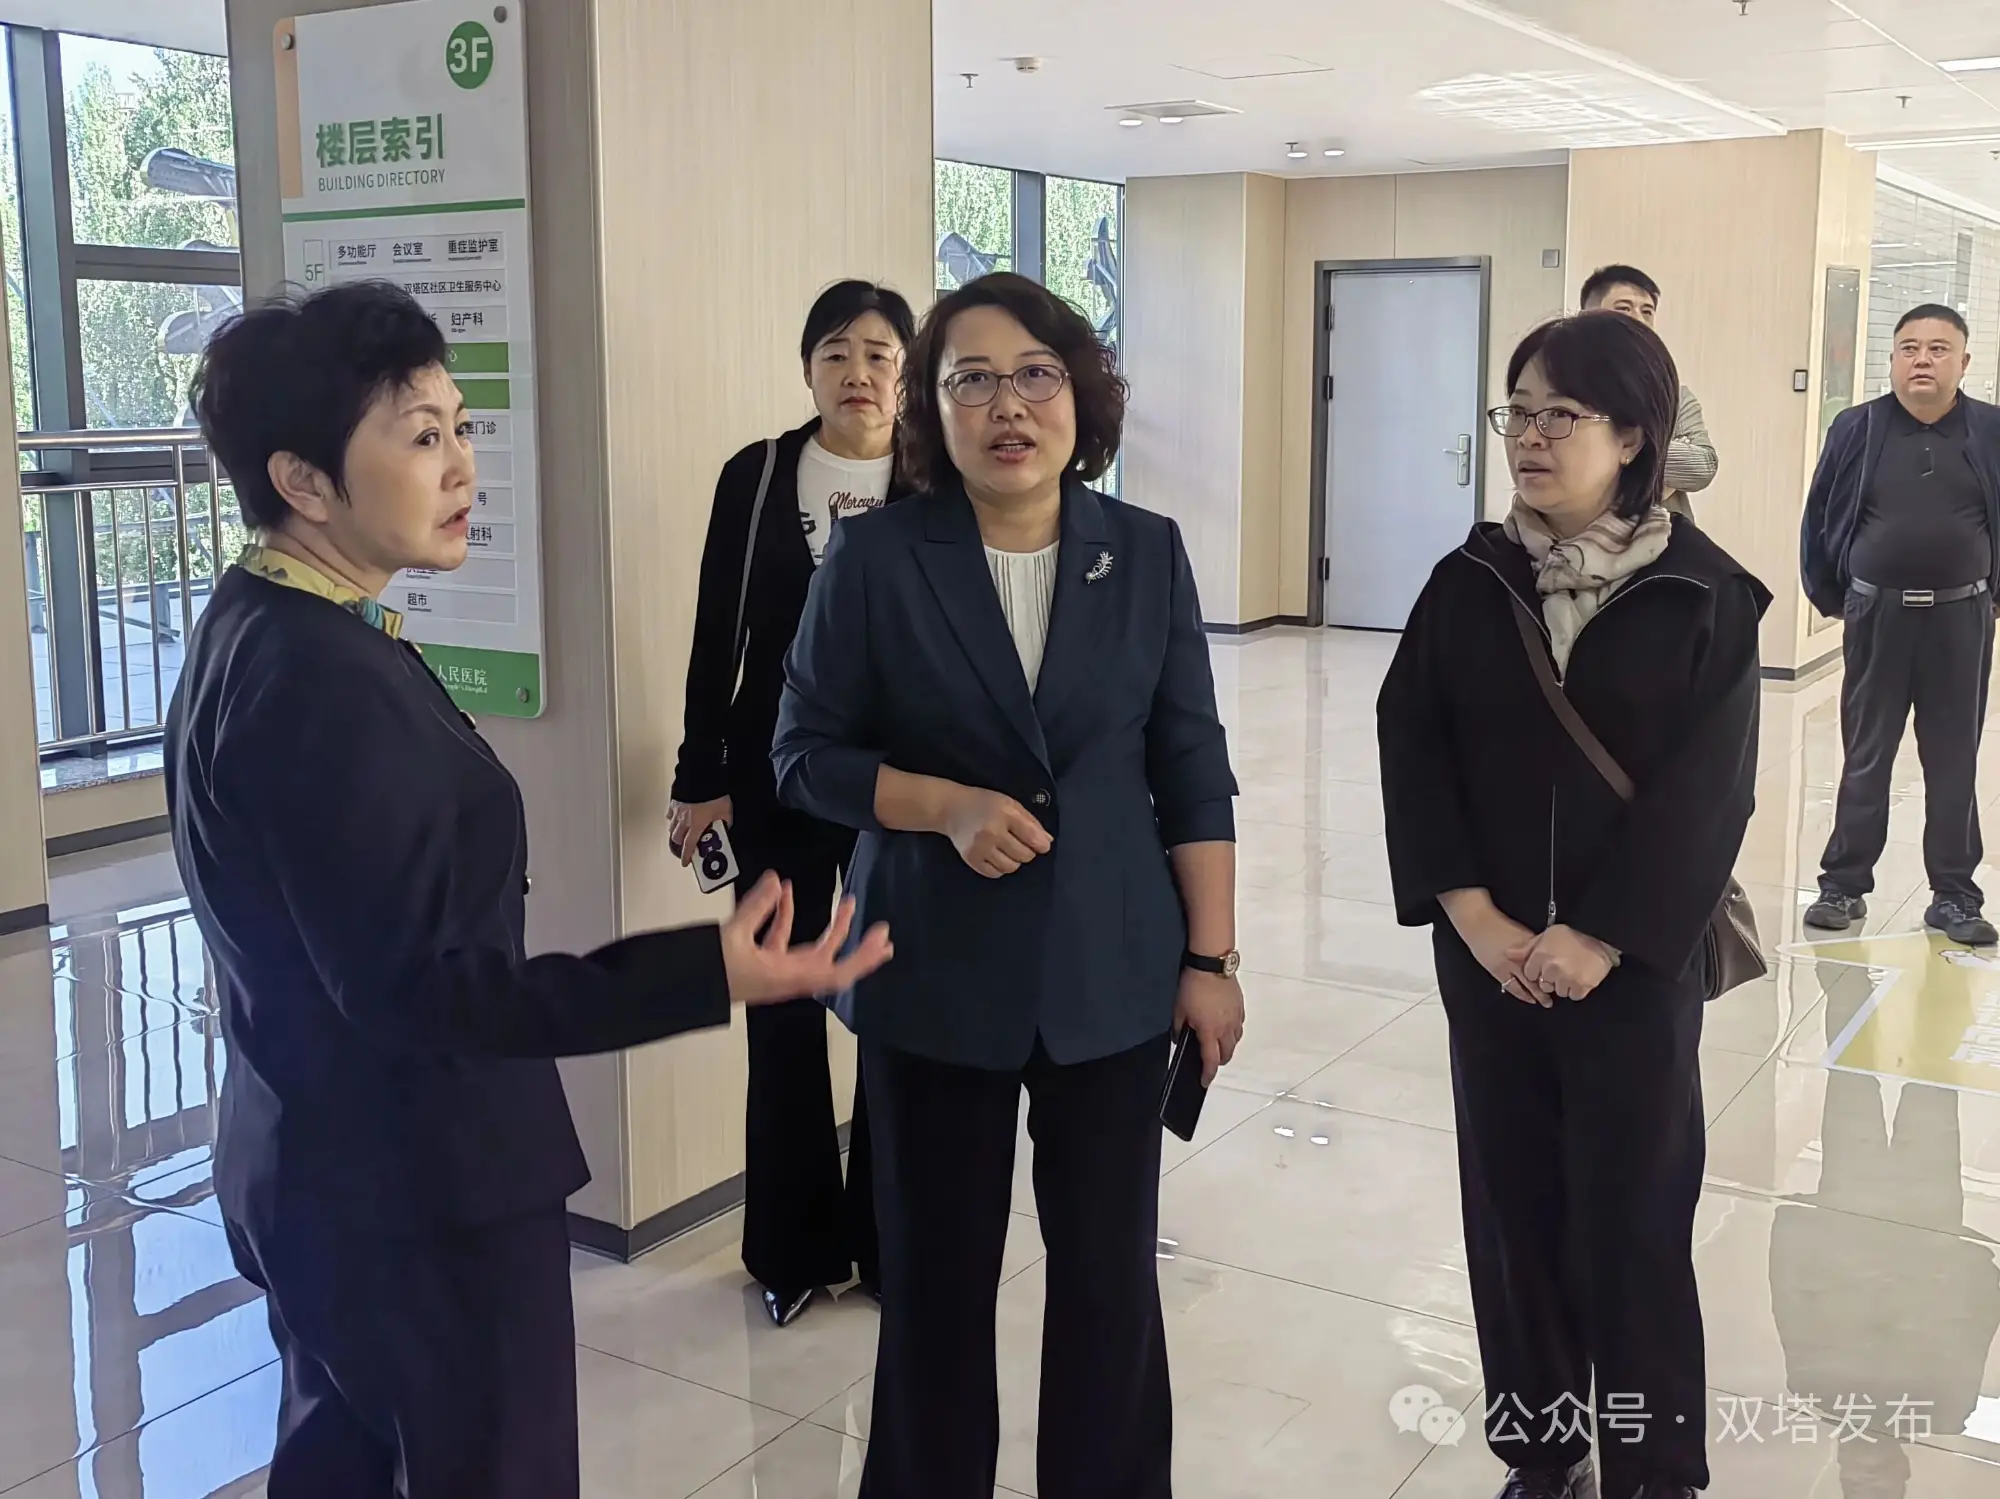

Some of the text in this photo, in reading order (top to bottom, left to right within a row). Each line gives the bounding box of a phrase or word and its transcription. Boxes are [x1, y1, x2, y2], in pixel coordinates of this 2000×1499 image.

[449, 37, 489, 74] 3F
[315, 113, 444, 168] 楼层索引
[318, 169, 446, 192] BUILDING DIRECTORY
[338, 238, 499, 259] 多功能厅 会议室 重症监护室
[305, 264, 324, 281] 5F
[451, 312, 483, 326] 妇产科
[477, 492, 488, 506] 号
[465, 526, 493, 542] 射科
[407, 592, 428, 607] 超市
[428, 664, 488, 686] 人民医院
